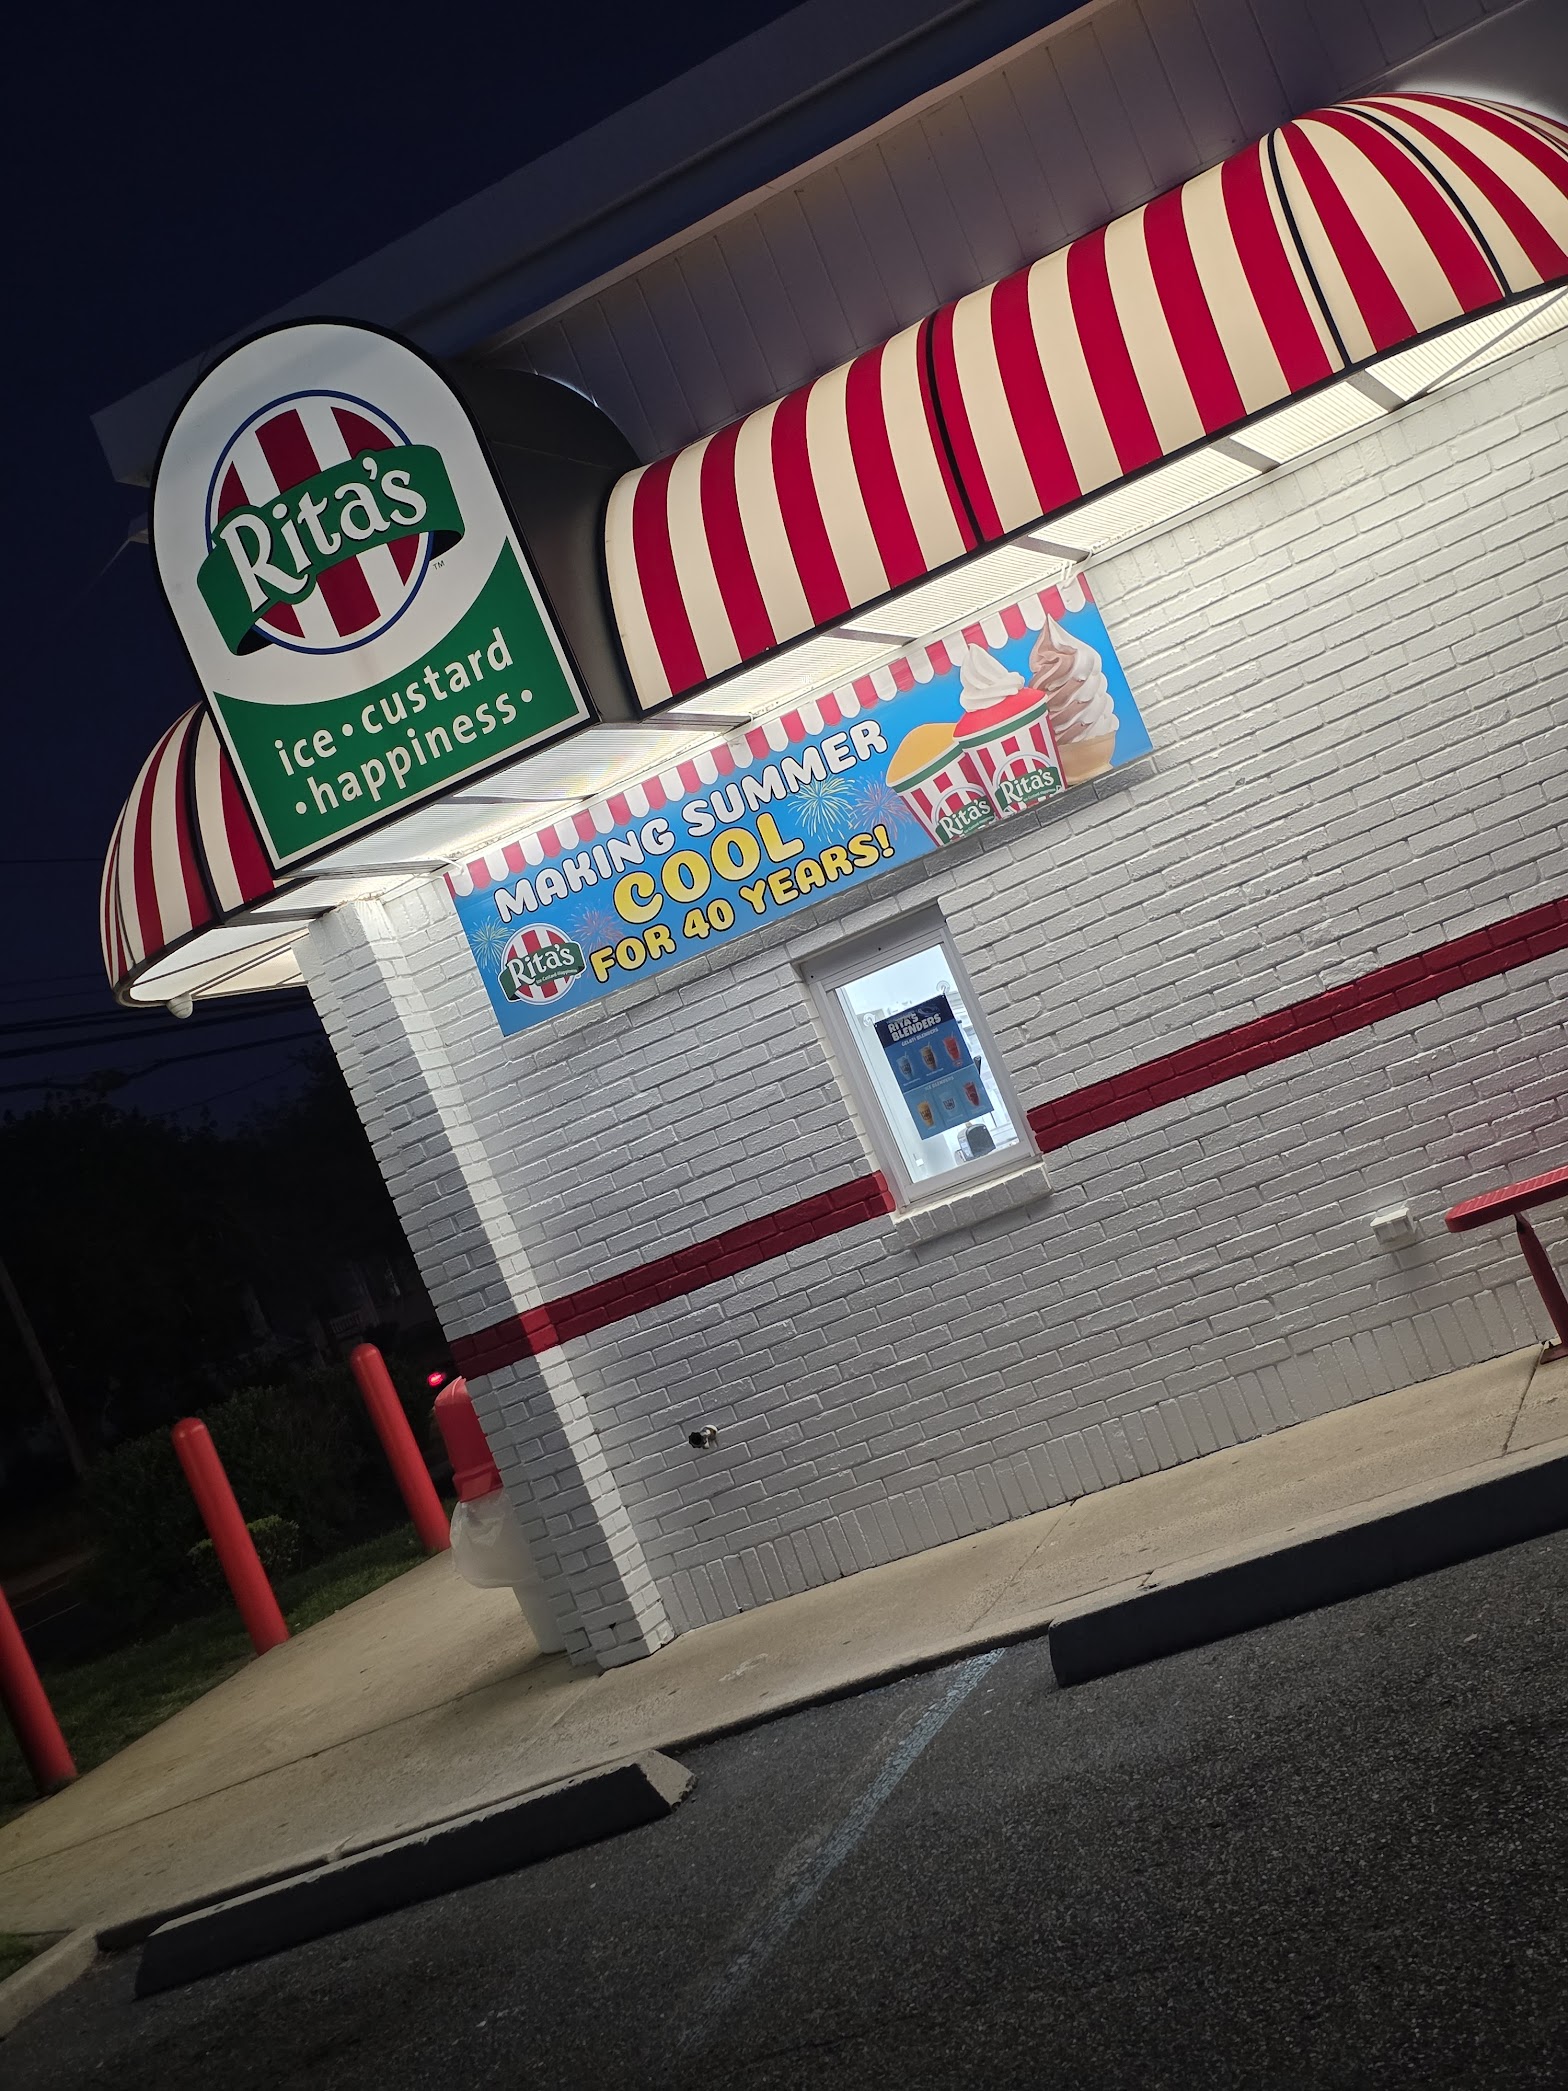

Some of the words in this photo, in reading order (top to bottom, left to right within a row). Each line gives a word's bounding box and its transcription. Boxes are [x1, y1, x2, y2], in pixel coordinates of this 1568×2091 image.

[219, 456, 427, 612] Rita's
[273, 725, 337, 776] ice
[361, 627, 514, 734] custard
[308, 700, 517, 815] happiness
[1000, 768, 1055, 805] Rita's
[494, 817, 676, 923] MAKING
[681, 719, 888, 838] SUMMER
[613, 813, 805, 924] COOL
[938, 799, 991, 839] Rita's
[590, 923, 676, 983] FOR
[682, 898, 736, 940] 40
[739, 824, 895, 915] YEARS!
[507, 943, 575, 988] Rita's
[887, 1012, 919, 1034] RITA'S
[891, 1013, 942, 1042] BLENDERS
